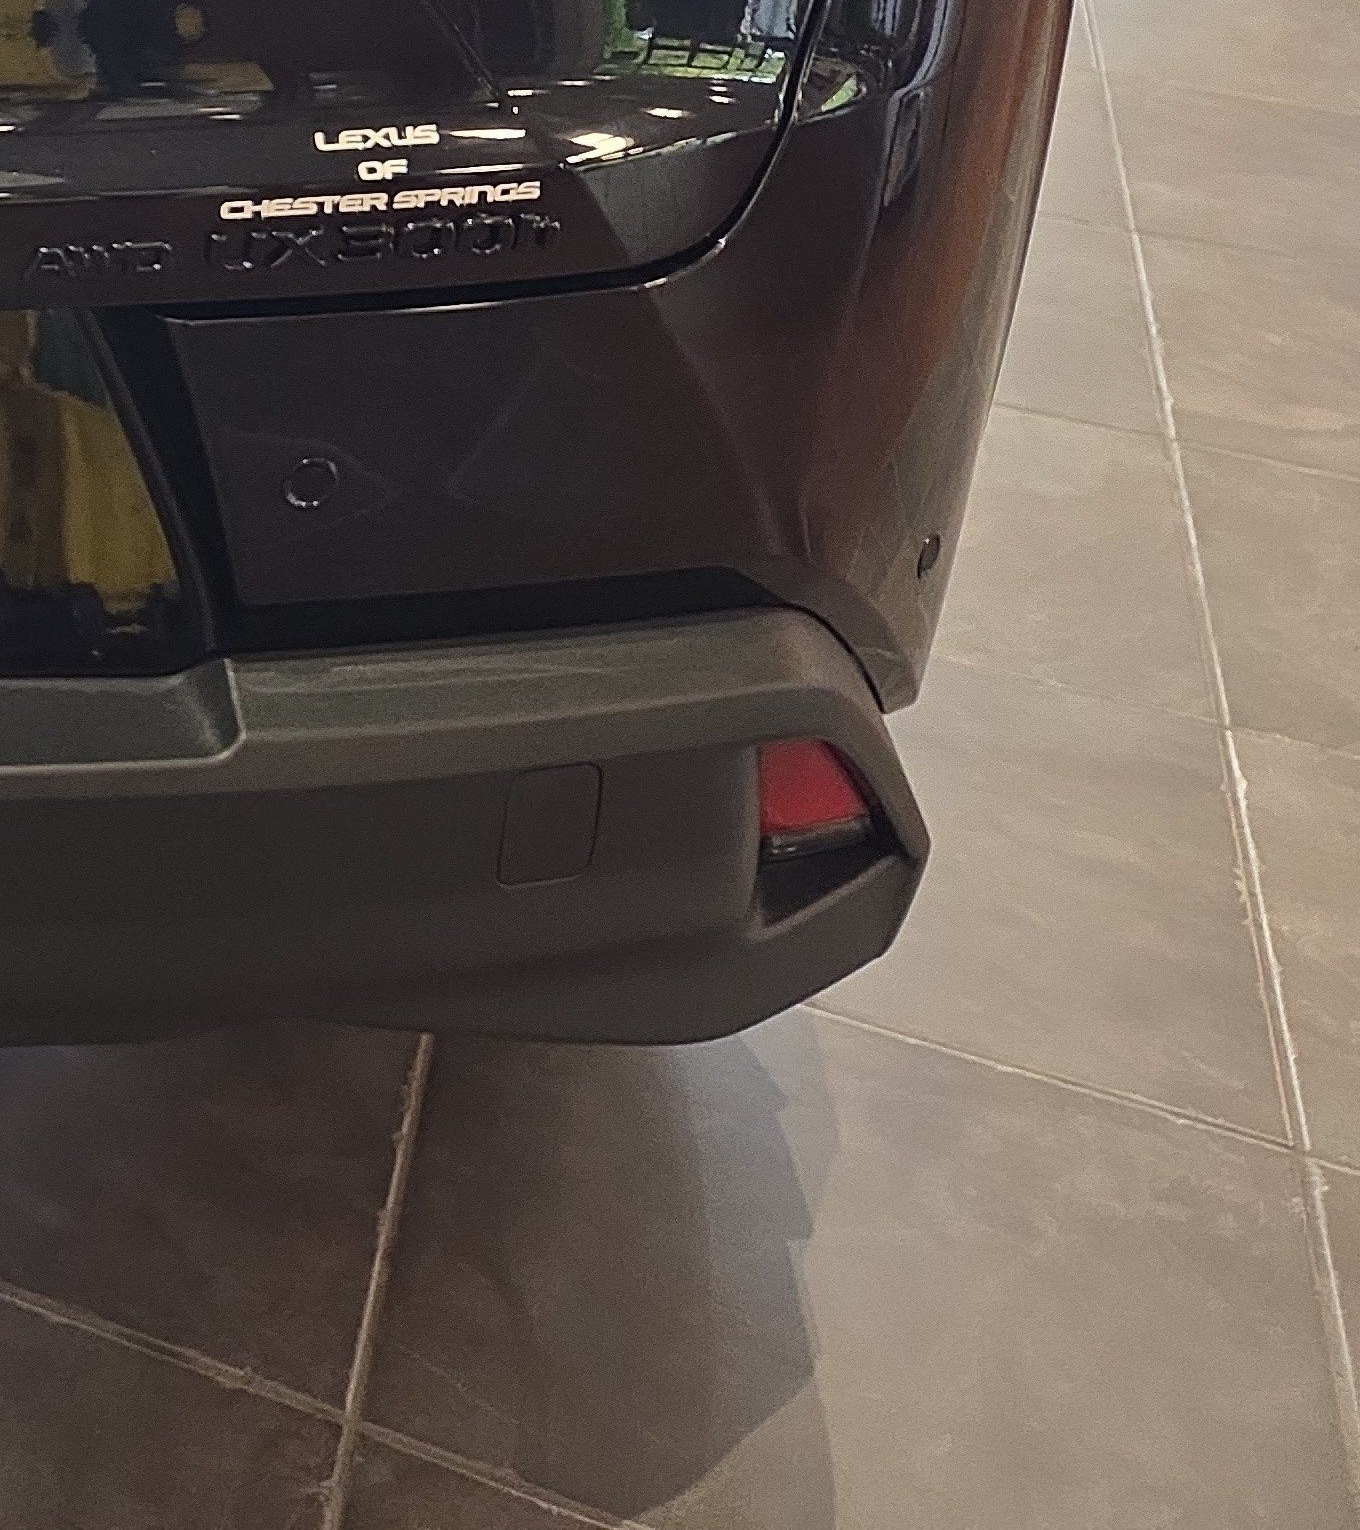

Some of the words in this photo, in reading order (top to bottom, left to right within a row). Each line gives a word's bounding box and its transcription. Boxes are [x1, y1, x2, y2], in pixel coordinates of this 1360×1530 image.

[314, 123, 441, 152] LEXUS
[357, 158, 409, 181] OF
[219, 192, 389, 220] CHESTER
[391, 180, 542, 210] SPRINGS
[25, 242, 173, 278] AWD
